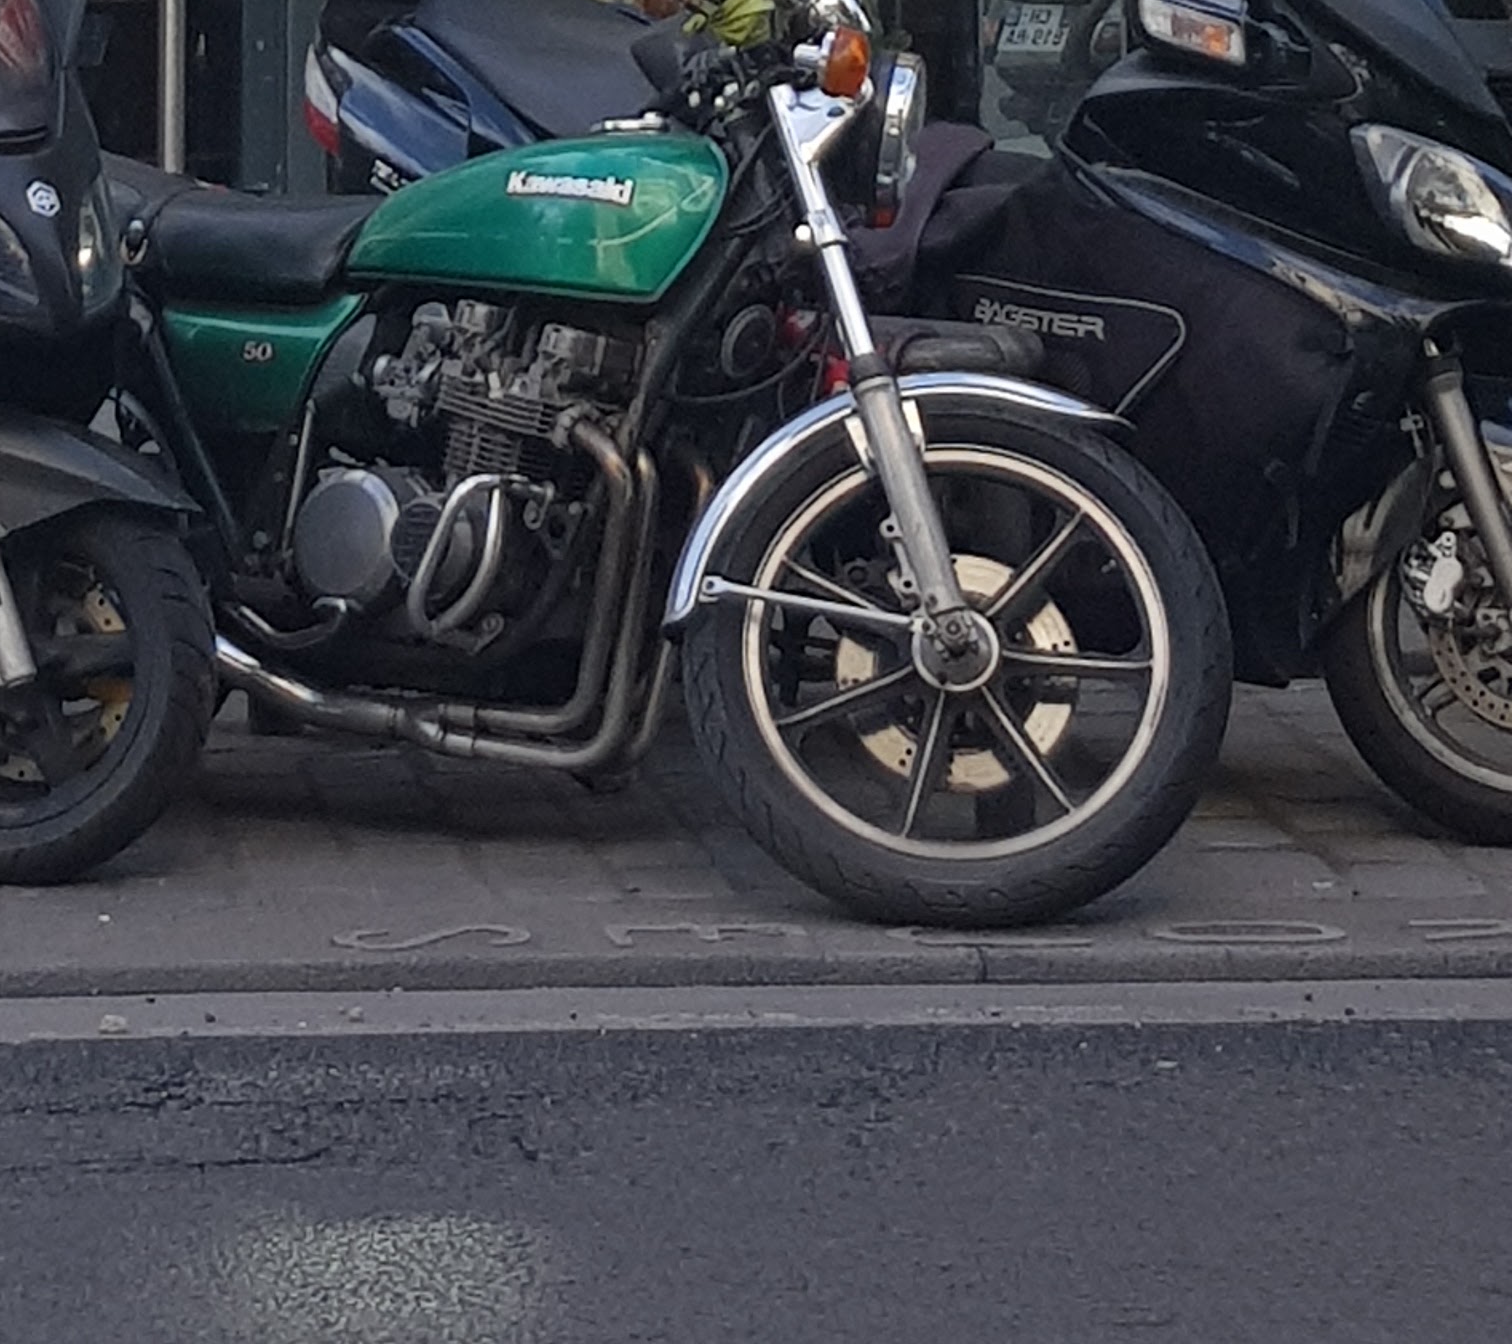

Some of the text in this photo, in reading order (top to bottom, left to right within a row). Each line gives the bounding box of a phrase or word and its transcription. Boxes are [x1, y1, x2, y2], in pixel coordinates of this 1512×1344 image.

[507, 171, 634, 206] Kawasaki
[974, 297, 1105, 342] BAGSTER
[243, 340, 273, 361] 50
